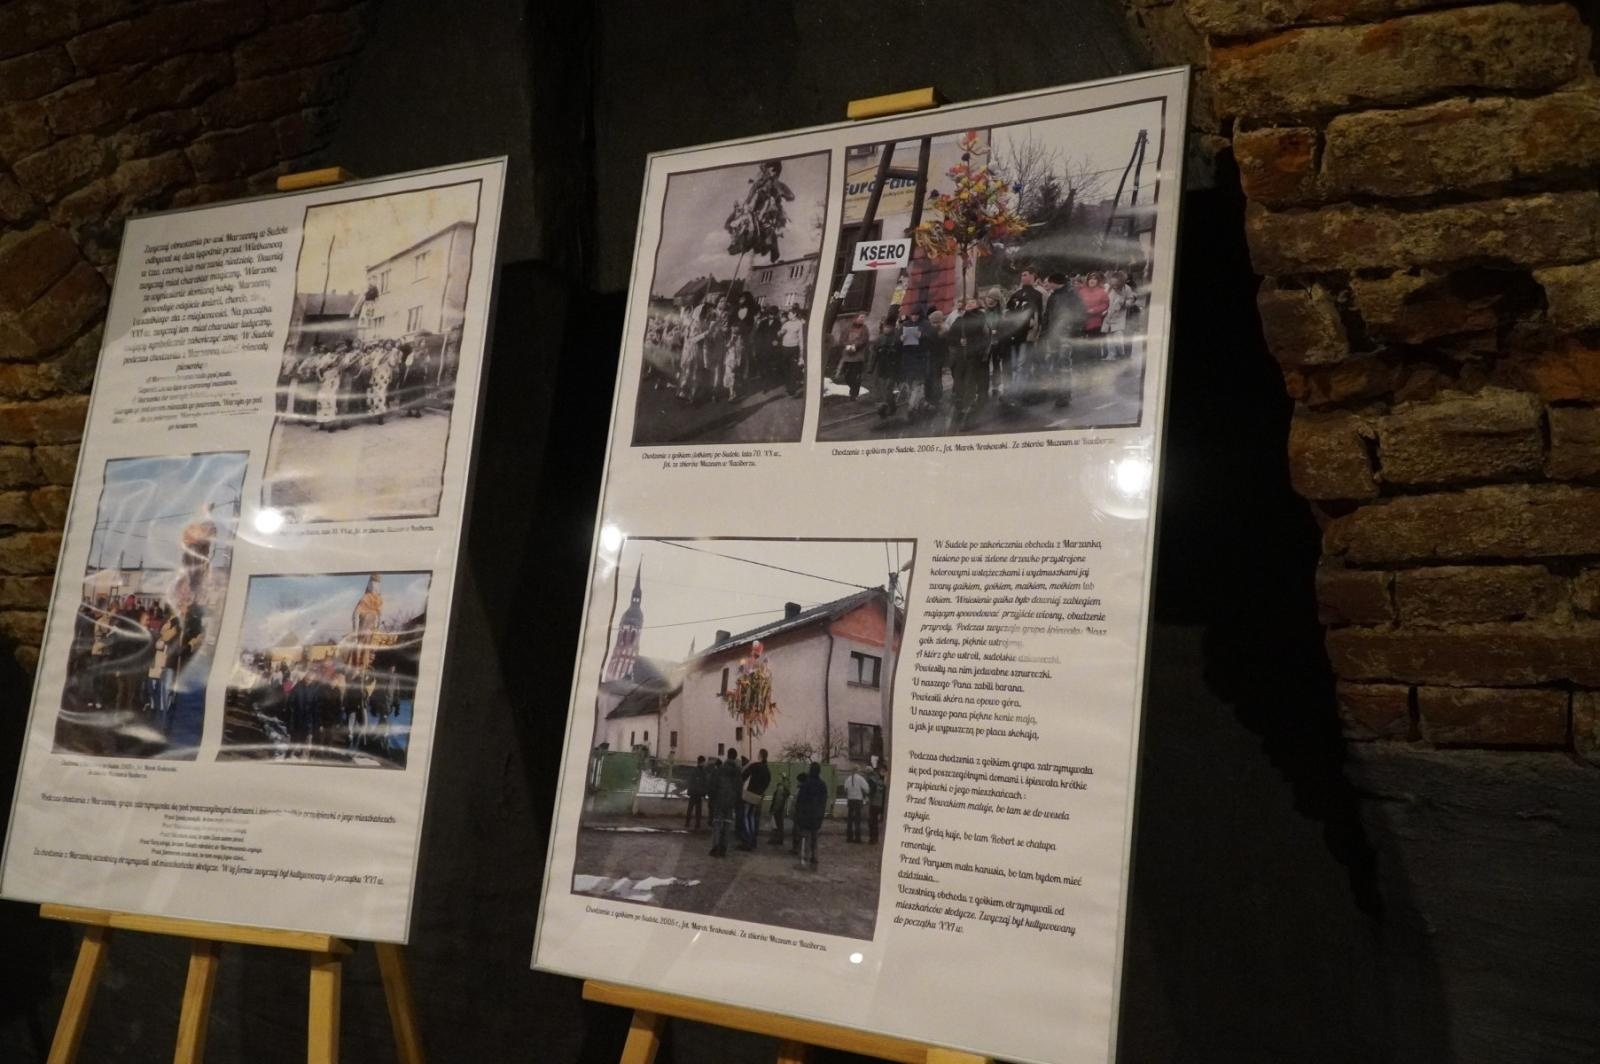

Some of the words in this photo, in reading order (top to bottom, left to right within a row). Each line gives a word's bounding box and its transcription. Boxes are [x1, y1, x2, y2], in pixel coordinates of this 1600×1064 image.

[859, 244, 905, 261] KSERO
[969, 542, 978, 551] po
[961, 556, 969, 565] po
[958, 666, 973, 675] nim
[1011, 761, 1035, 772] grupa
